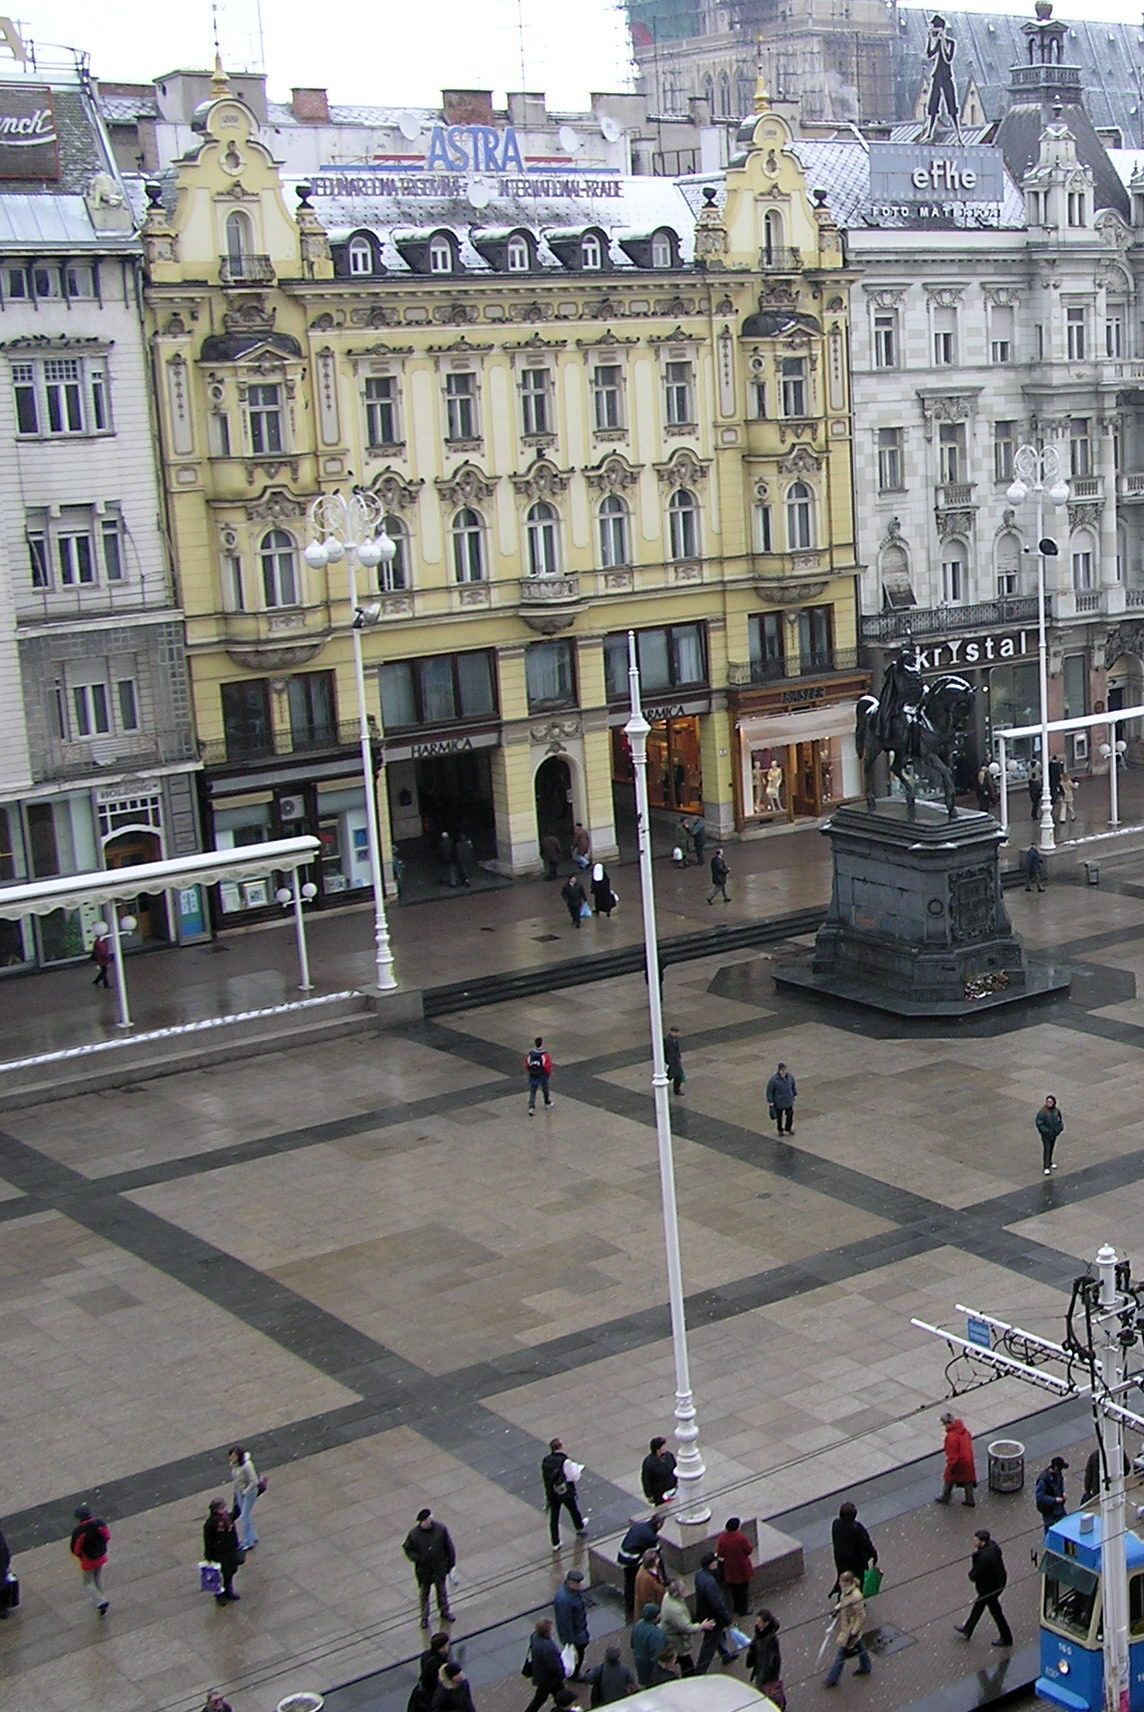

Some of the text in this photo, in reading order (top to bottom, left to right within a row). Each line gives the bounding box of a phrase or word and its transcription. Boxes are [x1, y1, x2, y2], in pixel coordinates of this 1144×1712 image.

[0, 109, 54, 135] nck
[427, 124, 524, 173] ASTRA
[912, 159, 977, 189] efke
[872, 206, 909, 218] FOTO
[641, 704, 685, 722] ARMICA
[411, 738, 473, 759] HARMICA
